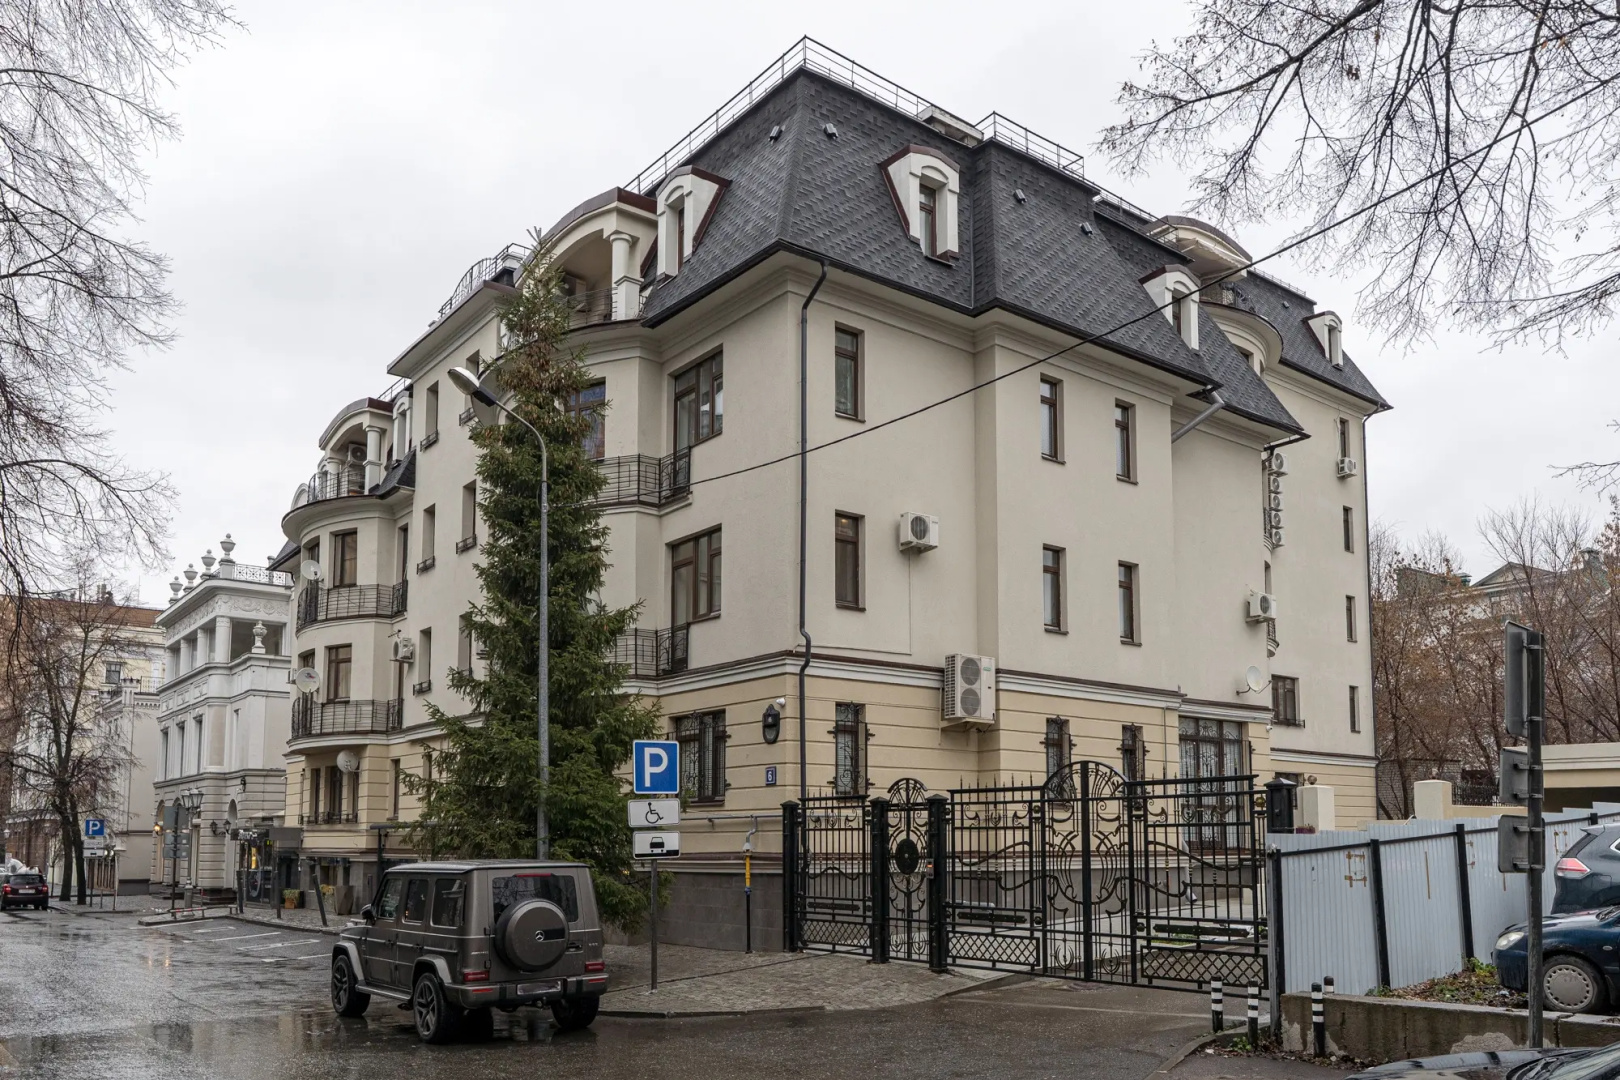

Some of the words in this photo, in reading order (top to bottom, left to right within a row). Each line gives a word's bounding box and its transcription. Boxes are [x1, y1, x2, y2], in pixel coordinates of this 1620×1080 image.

[644, 747, 668, 787] P
[767, 770, 773, 782] 6
[88, 820, 101, 835] P
